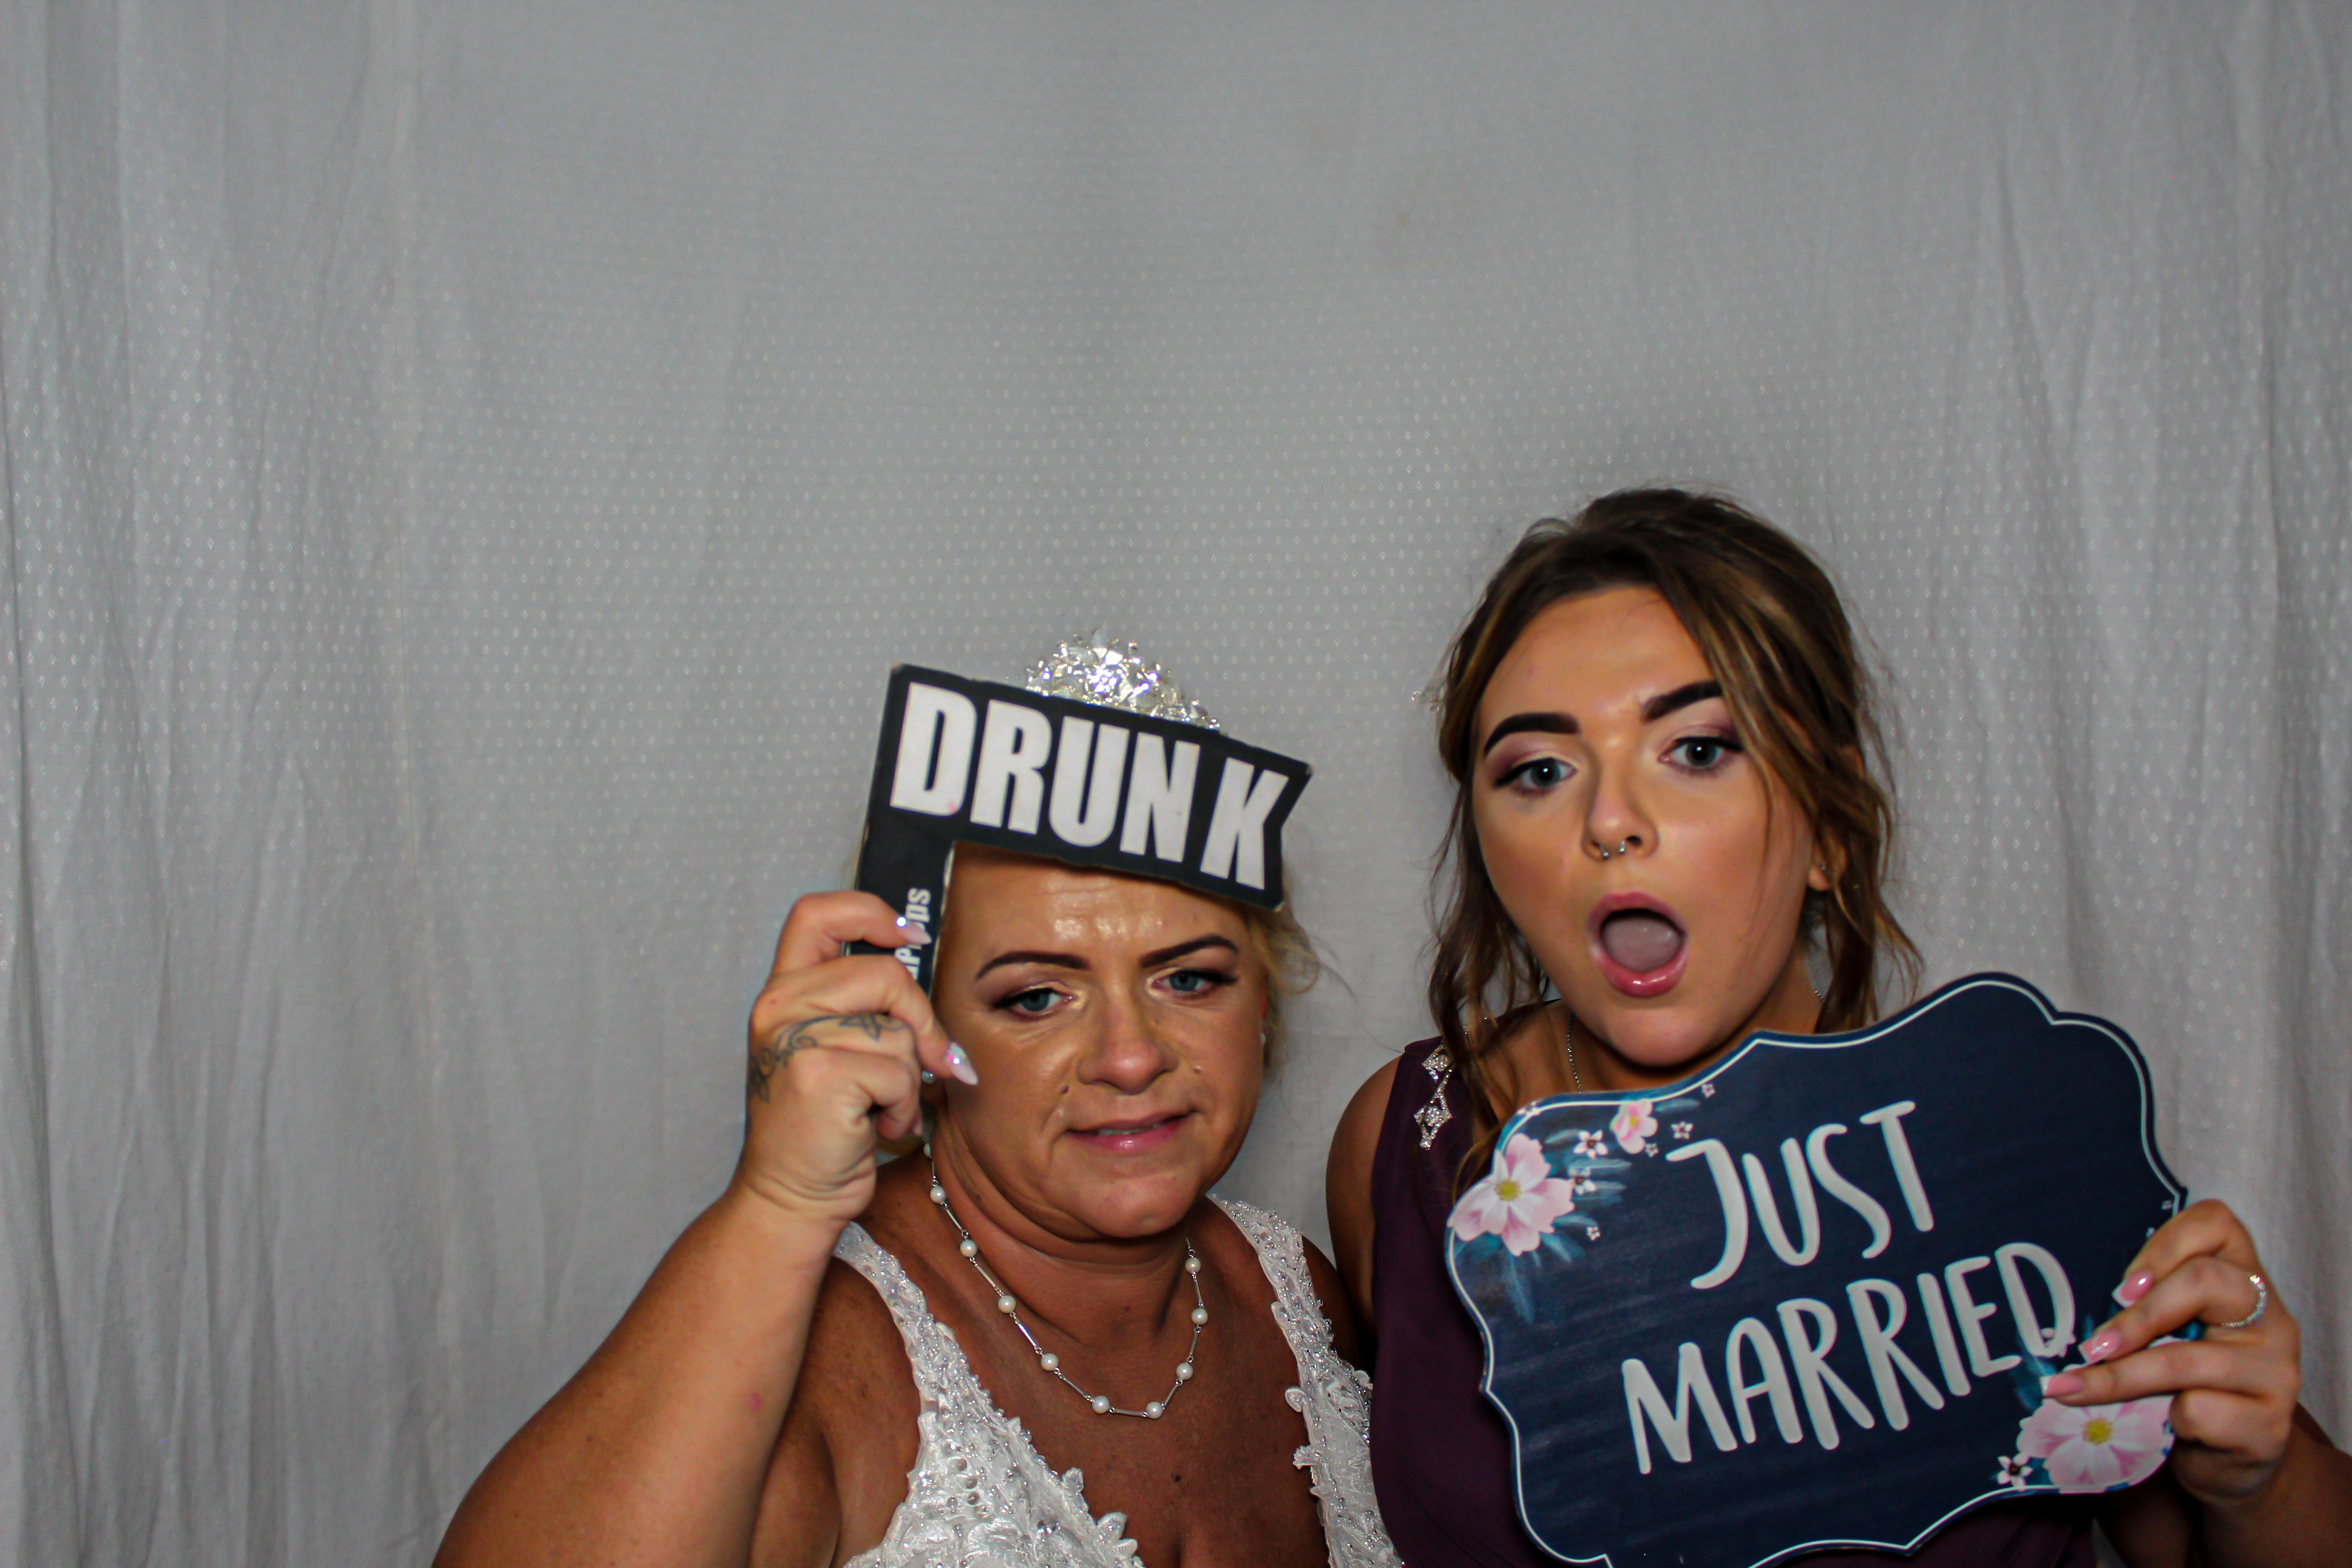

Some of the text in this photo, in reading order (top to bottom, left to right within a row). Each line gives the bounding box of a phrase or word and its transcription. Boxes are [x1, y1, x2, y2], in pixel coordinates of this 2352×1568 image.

[890, 682, 1289, 890] DRUNK
[1666, 1101, 1935, 1289] JUST
[1621, 1242, 2076, 1475] MARRIED
